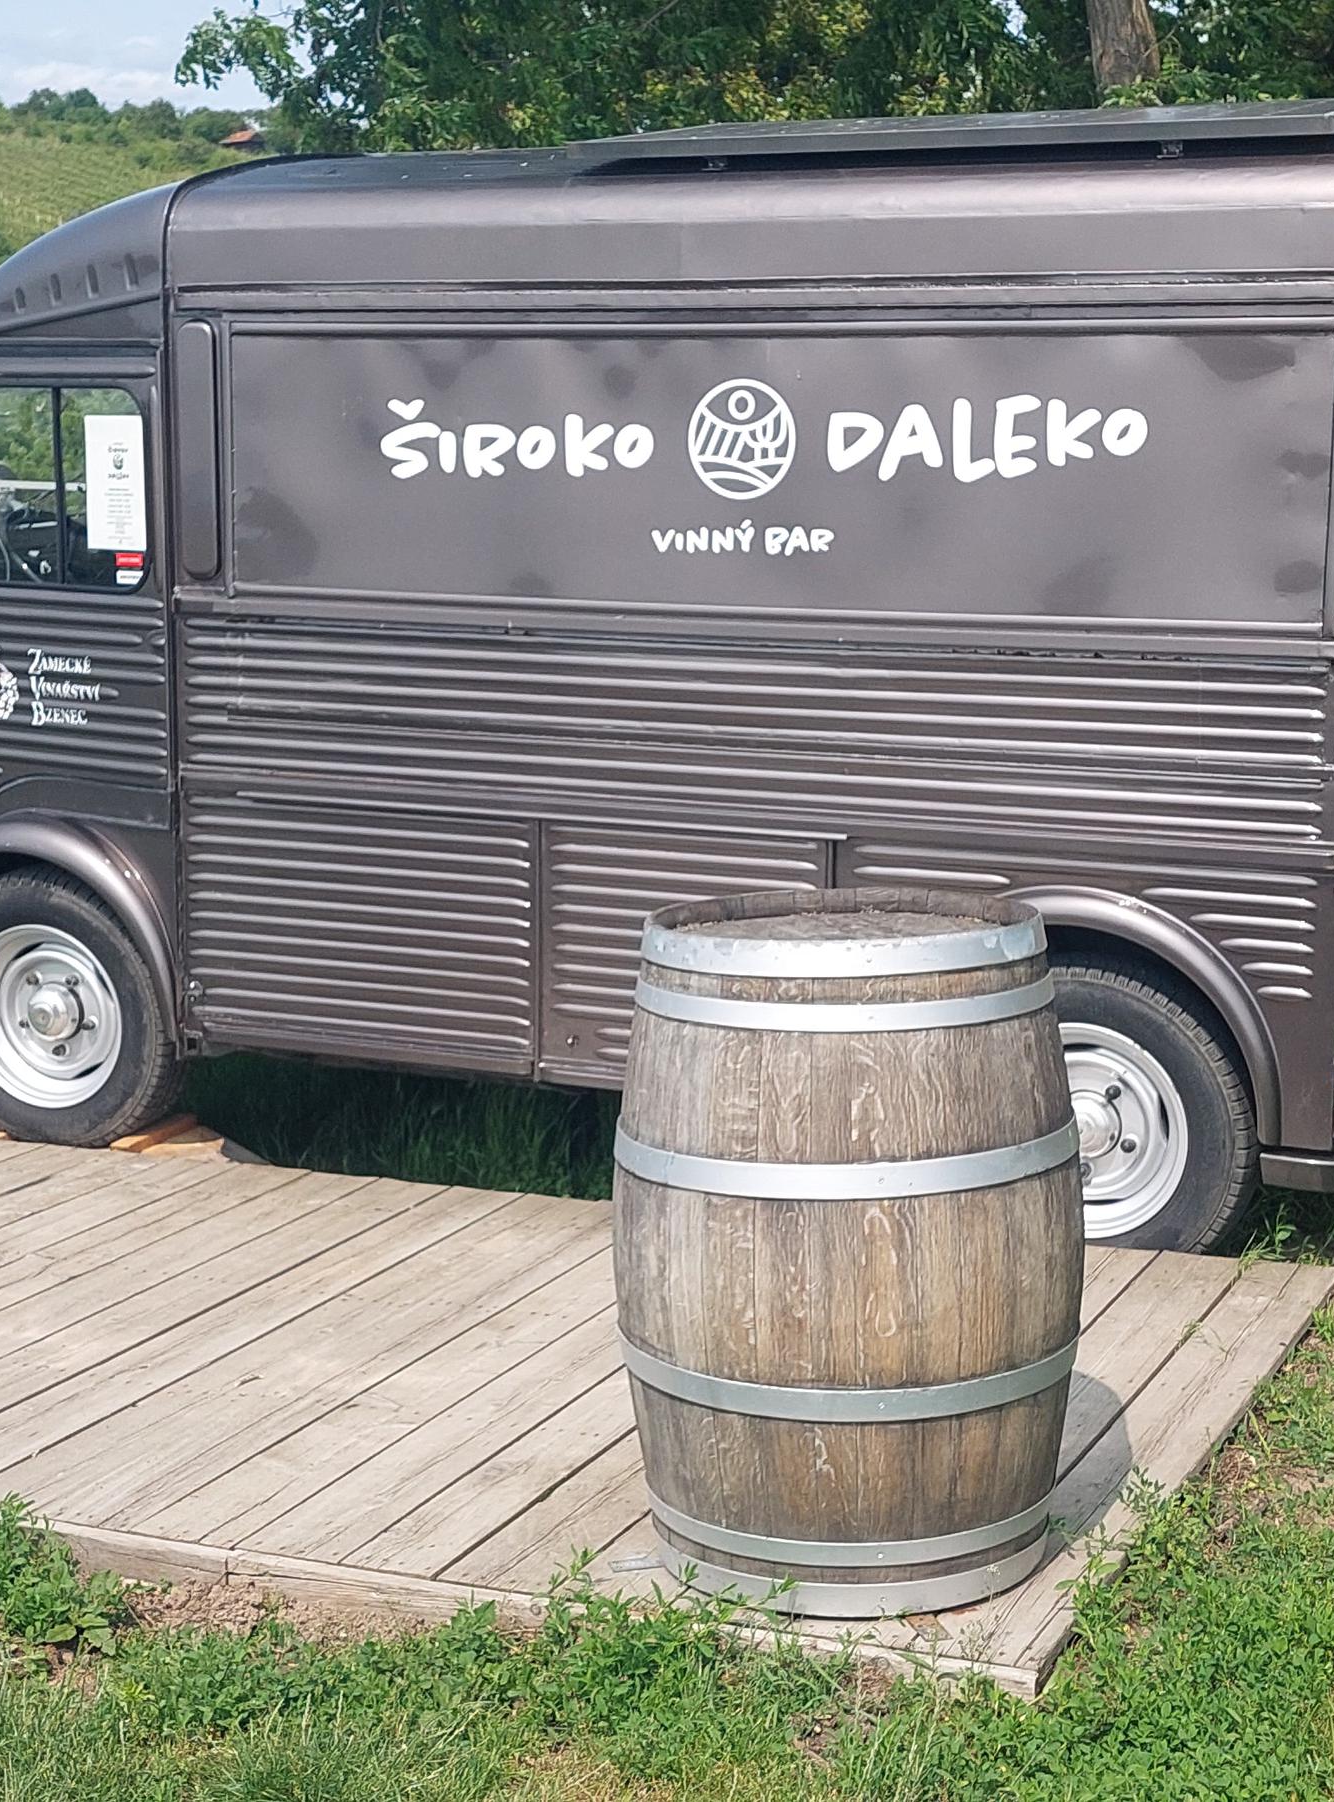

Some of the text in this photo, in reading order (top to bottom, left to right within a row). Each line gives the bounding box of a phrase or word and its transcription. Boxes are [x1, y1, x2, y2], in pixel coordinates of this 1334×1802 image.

[379, 394, 1149, 483] ŠIROKO DALEKO
[651, 518, 835, 557] VINNÝ BAR
[30, 700, 89, 727] BZENEC
